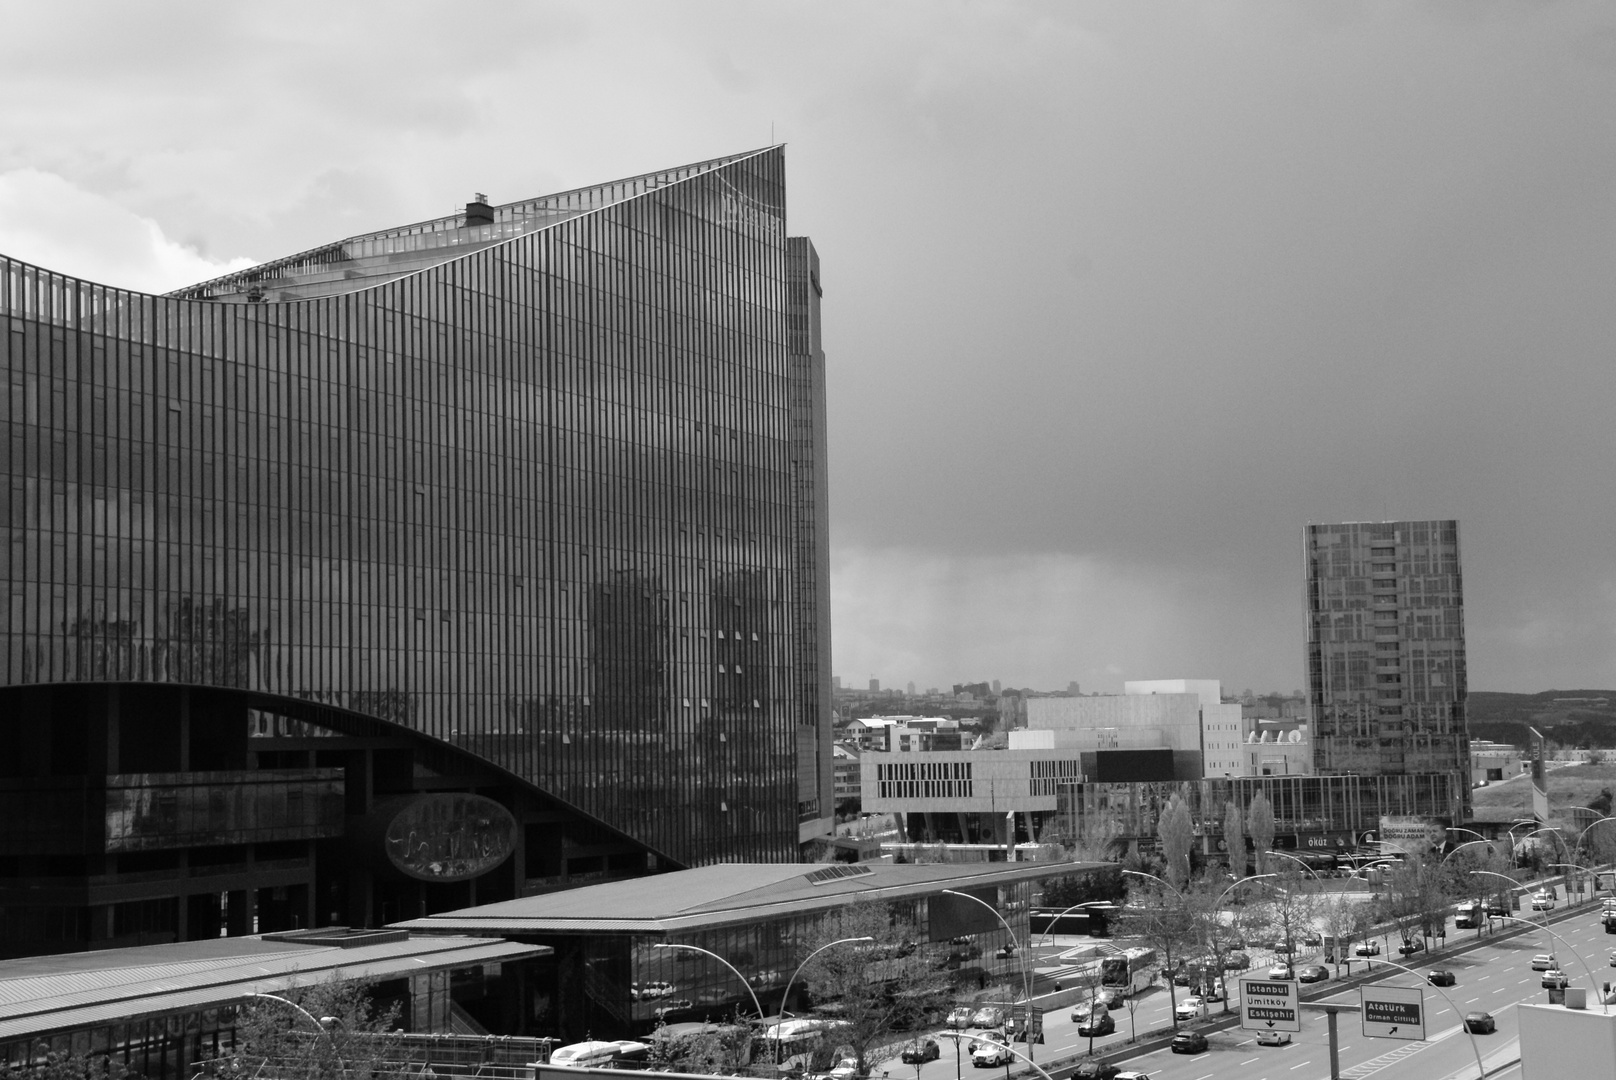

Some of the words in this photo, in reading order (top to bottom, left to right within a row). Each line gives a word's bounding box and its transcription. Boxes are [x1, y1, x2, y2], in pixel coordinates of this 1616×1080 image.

[1247, 996, 1287, 1007] Ümitköy
[1368, 1002, 1406, 1012] Atatürk
[1250, 1009, 1294, 1019] Eskişehir
[1368, 1013, 1390, 1021] Orman
